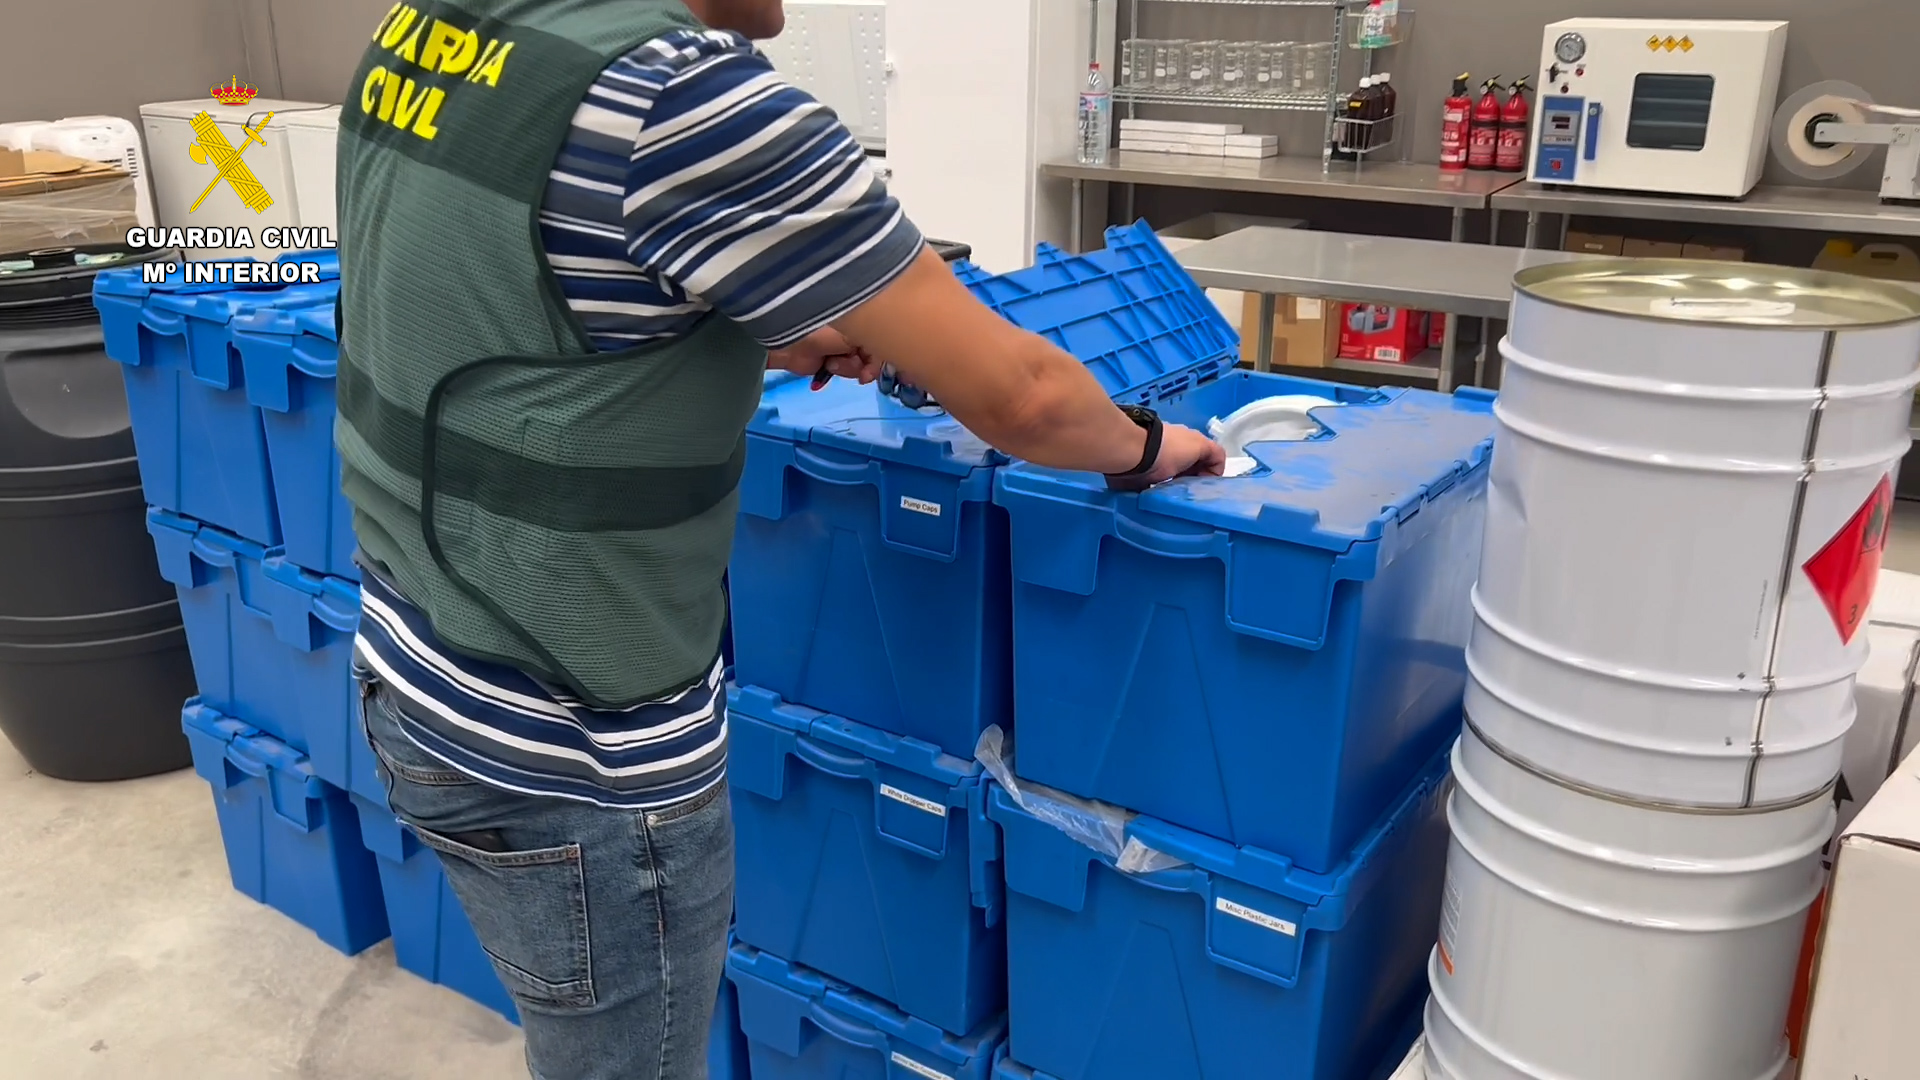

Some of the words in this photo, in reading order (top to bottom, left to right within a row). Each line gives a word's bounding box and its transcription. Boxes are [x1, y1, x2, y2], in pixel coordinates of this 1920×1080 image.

[922, 503, 938, 514] Caps
[1848, 603, 1858, 625] 3
[1224, 902, 1242, 915] Misc
[1243, 909, 1268, 925] Plastic
